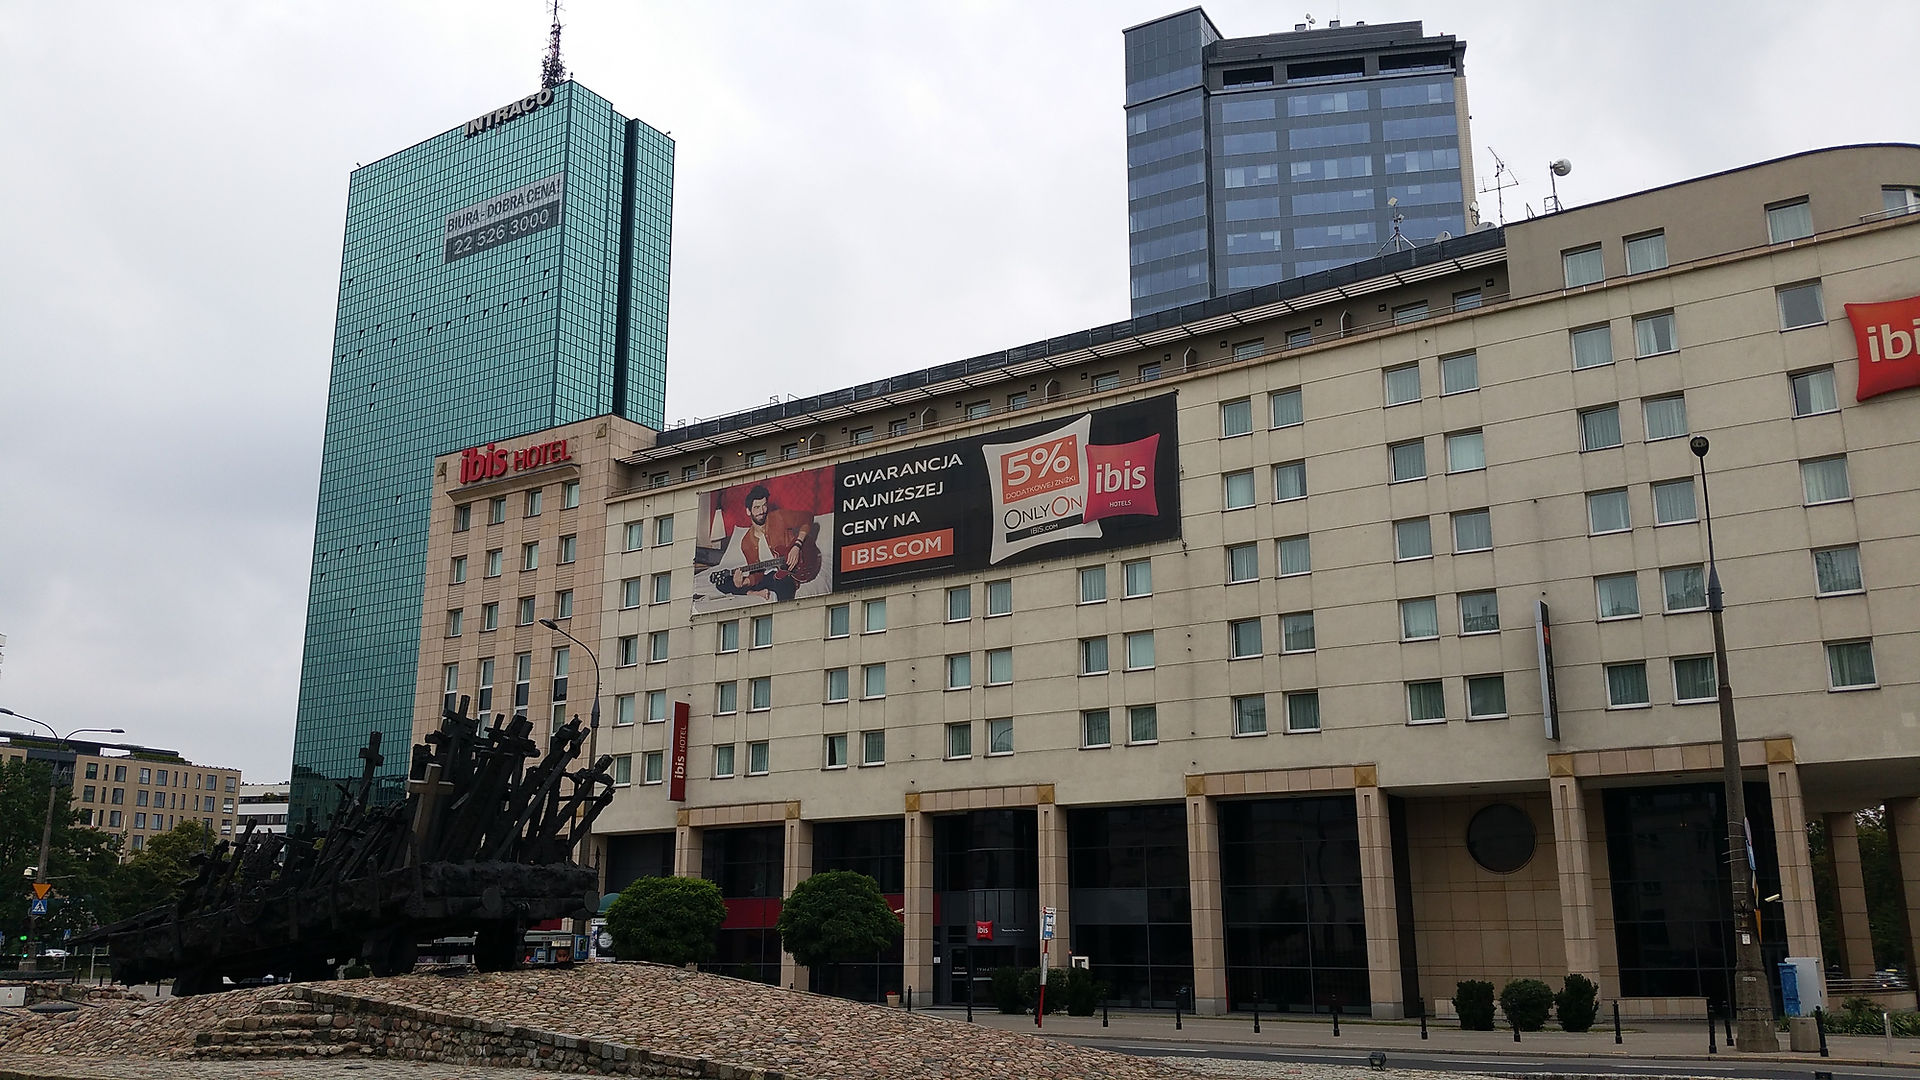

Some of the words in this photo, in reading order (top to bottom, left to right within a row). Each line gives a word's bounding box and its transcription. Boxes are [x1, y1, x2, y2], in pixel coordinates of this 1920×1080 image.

[464, 88, 553, 137] INTRACO
[447, 208, 479, 232] BIURA
[487, 194, 524, 219] DOBRA
[526, 179, 561, 203] CENA!
[453, 236, 473, 254] 22
[477, 224, 506, 246] 526
[510, 209, 549, 235] 3000
[460, 443, 508, 485] ibis
[513, 439, 572, 471] HOTEL
[843, 453, 964, 488] GWARANCJA
[1096, 460, 1147, 494] ibis
[842, 481, 944, 512] NAJNIŻSZEJ
[1006, 482, 1054, 499] DODATKOWEJ
[1109, 499, 1132, 508] HOTELS
[842, 516, 889, 536] CENY
[893, 511, 921, 528] NA
[850, 536, 942, 565] IBIS.COM
[675, 755, 685, 779] ibis
[977, 926, 989, 934] ibis
